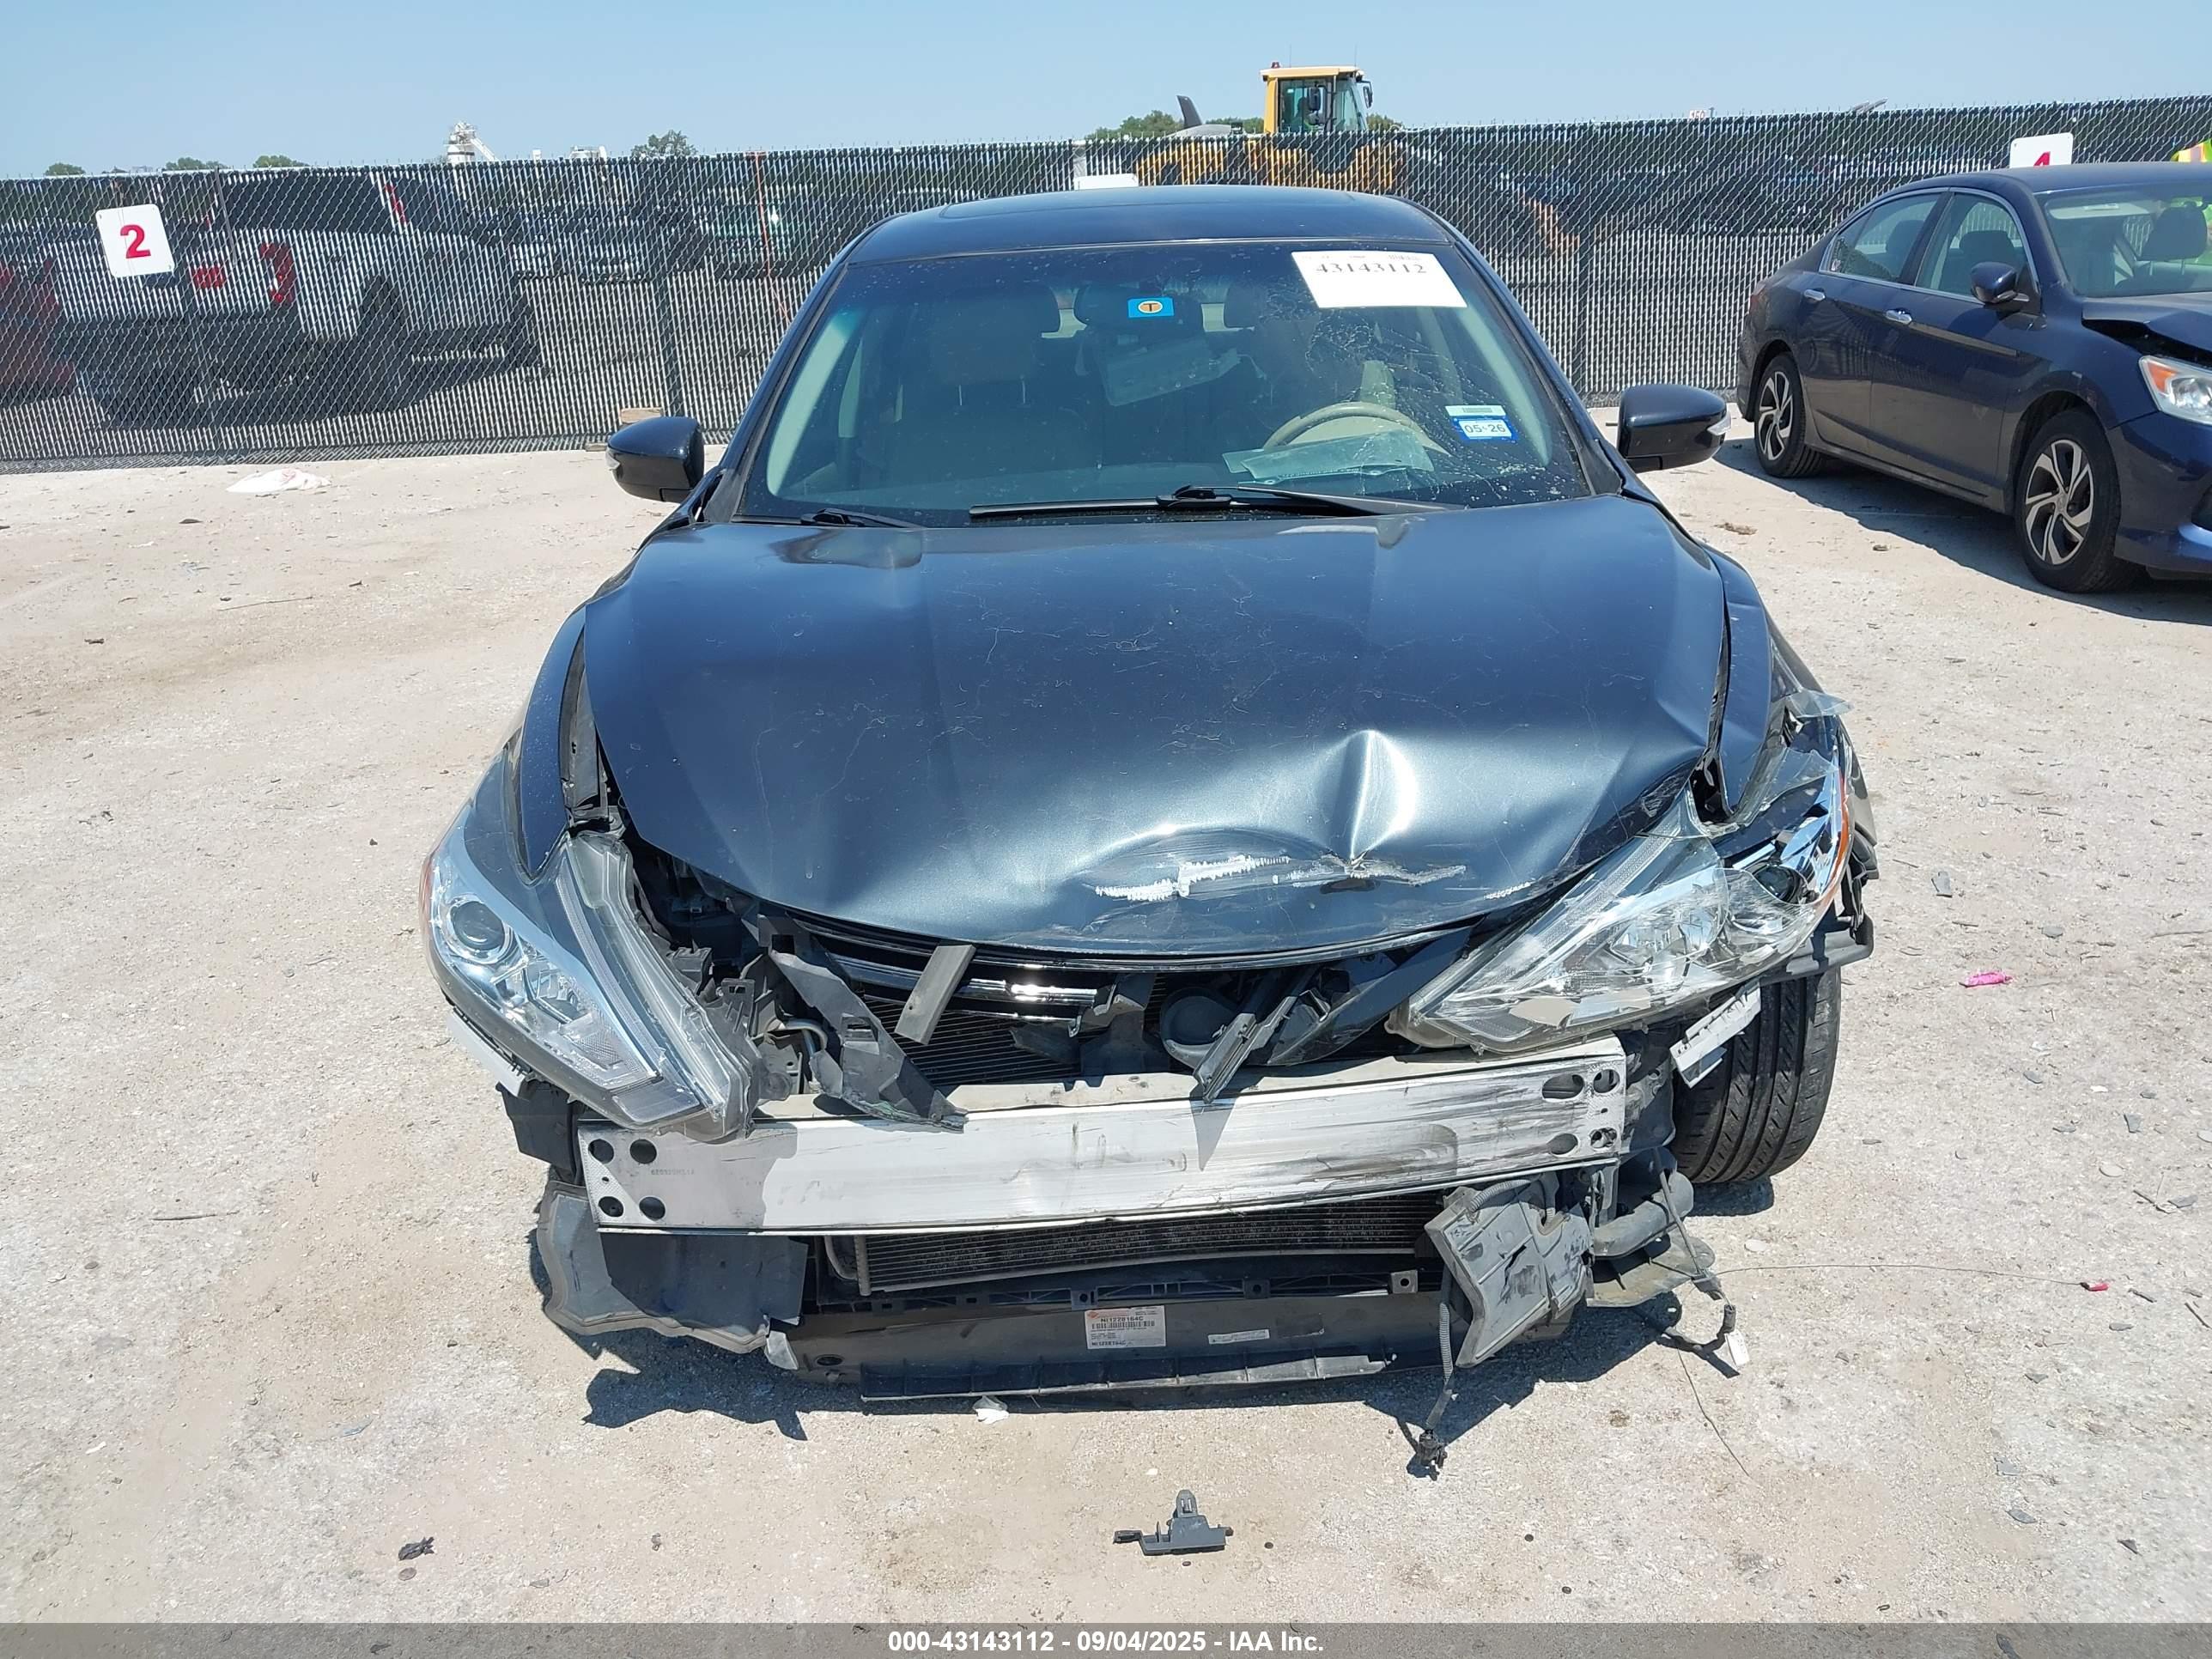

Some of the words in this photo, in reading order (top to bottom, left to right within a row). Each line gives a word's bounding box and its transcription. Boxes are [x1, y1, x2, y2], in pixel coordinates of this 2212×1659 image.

[119, 224, 151, 259] 2
[1316, 262, 1427, 274] 43143112
[1142, 302, 1158, 312] T
